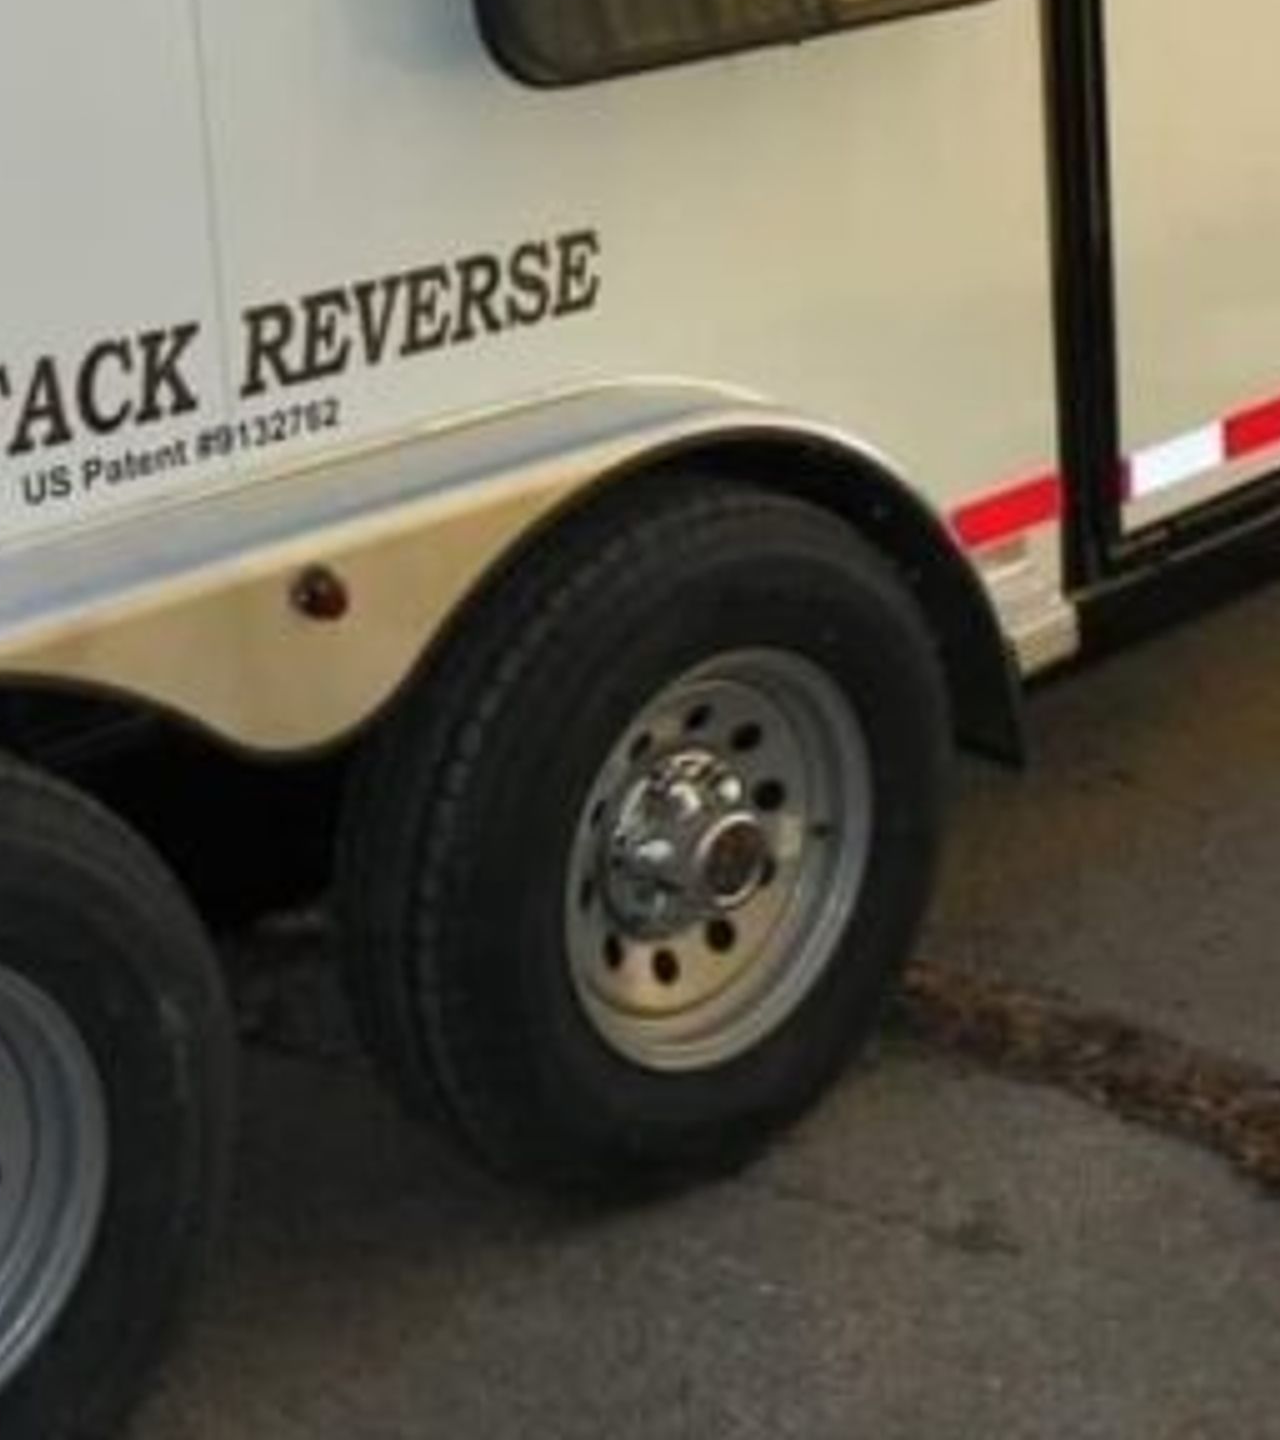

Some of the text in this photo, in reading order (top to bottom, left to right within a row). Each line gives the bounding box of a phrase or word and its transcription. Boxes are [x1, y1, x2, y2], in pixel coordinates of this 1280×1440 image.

[238, 229, 601, 398] REVERSE
[22, 465, 72, 505] US
[80, 439, 188, 490] Patent
